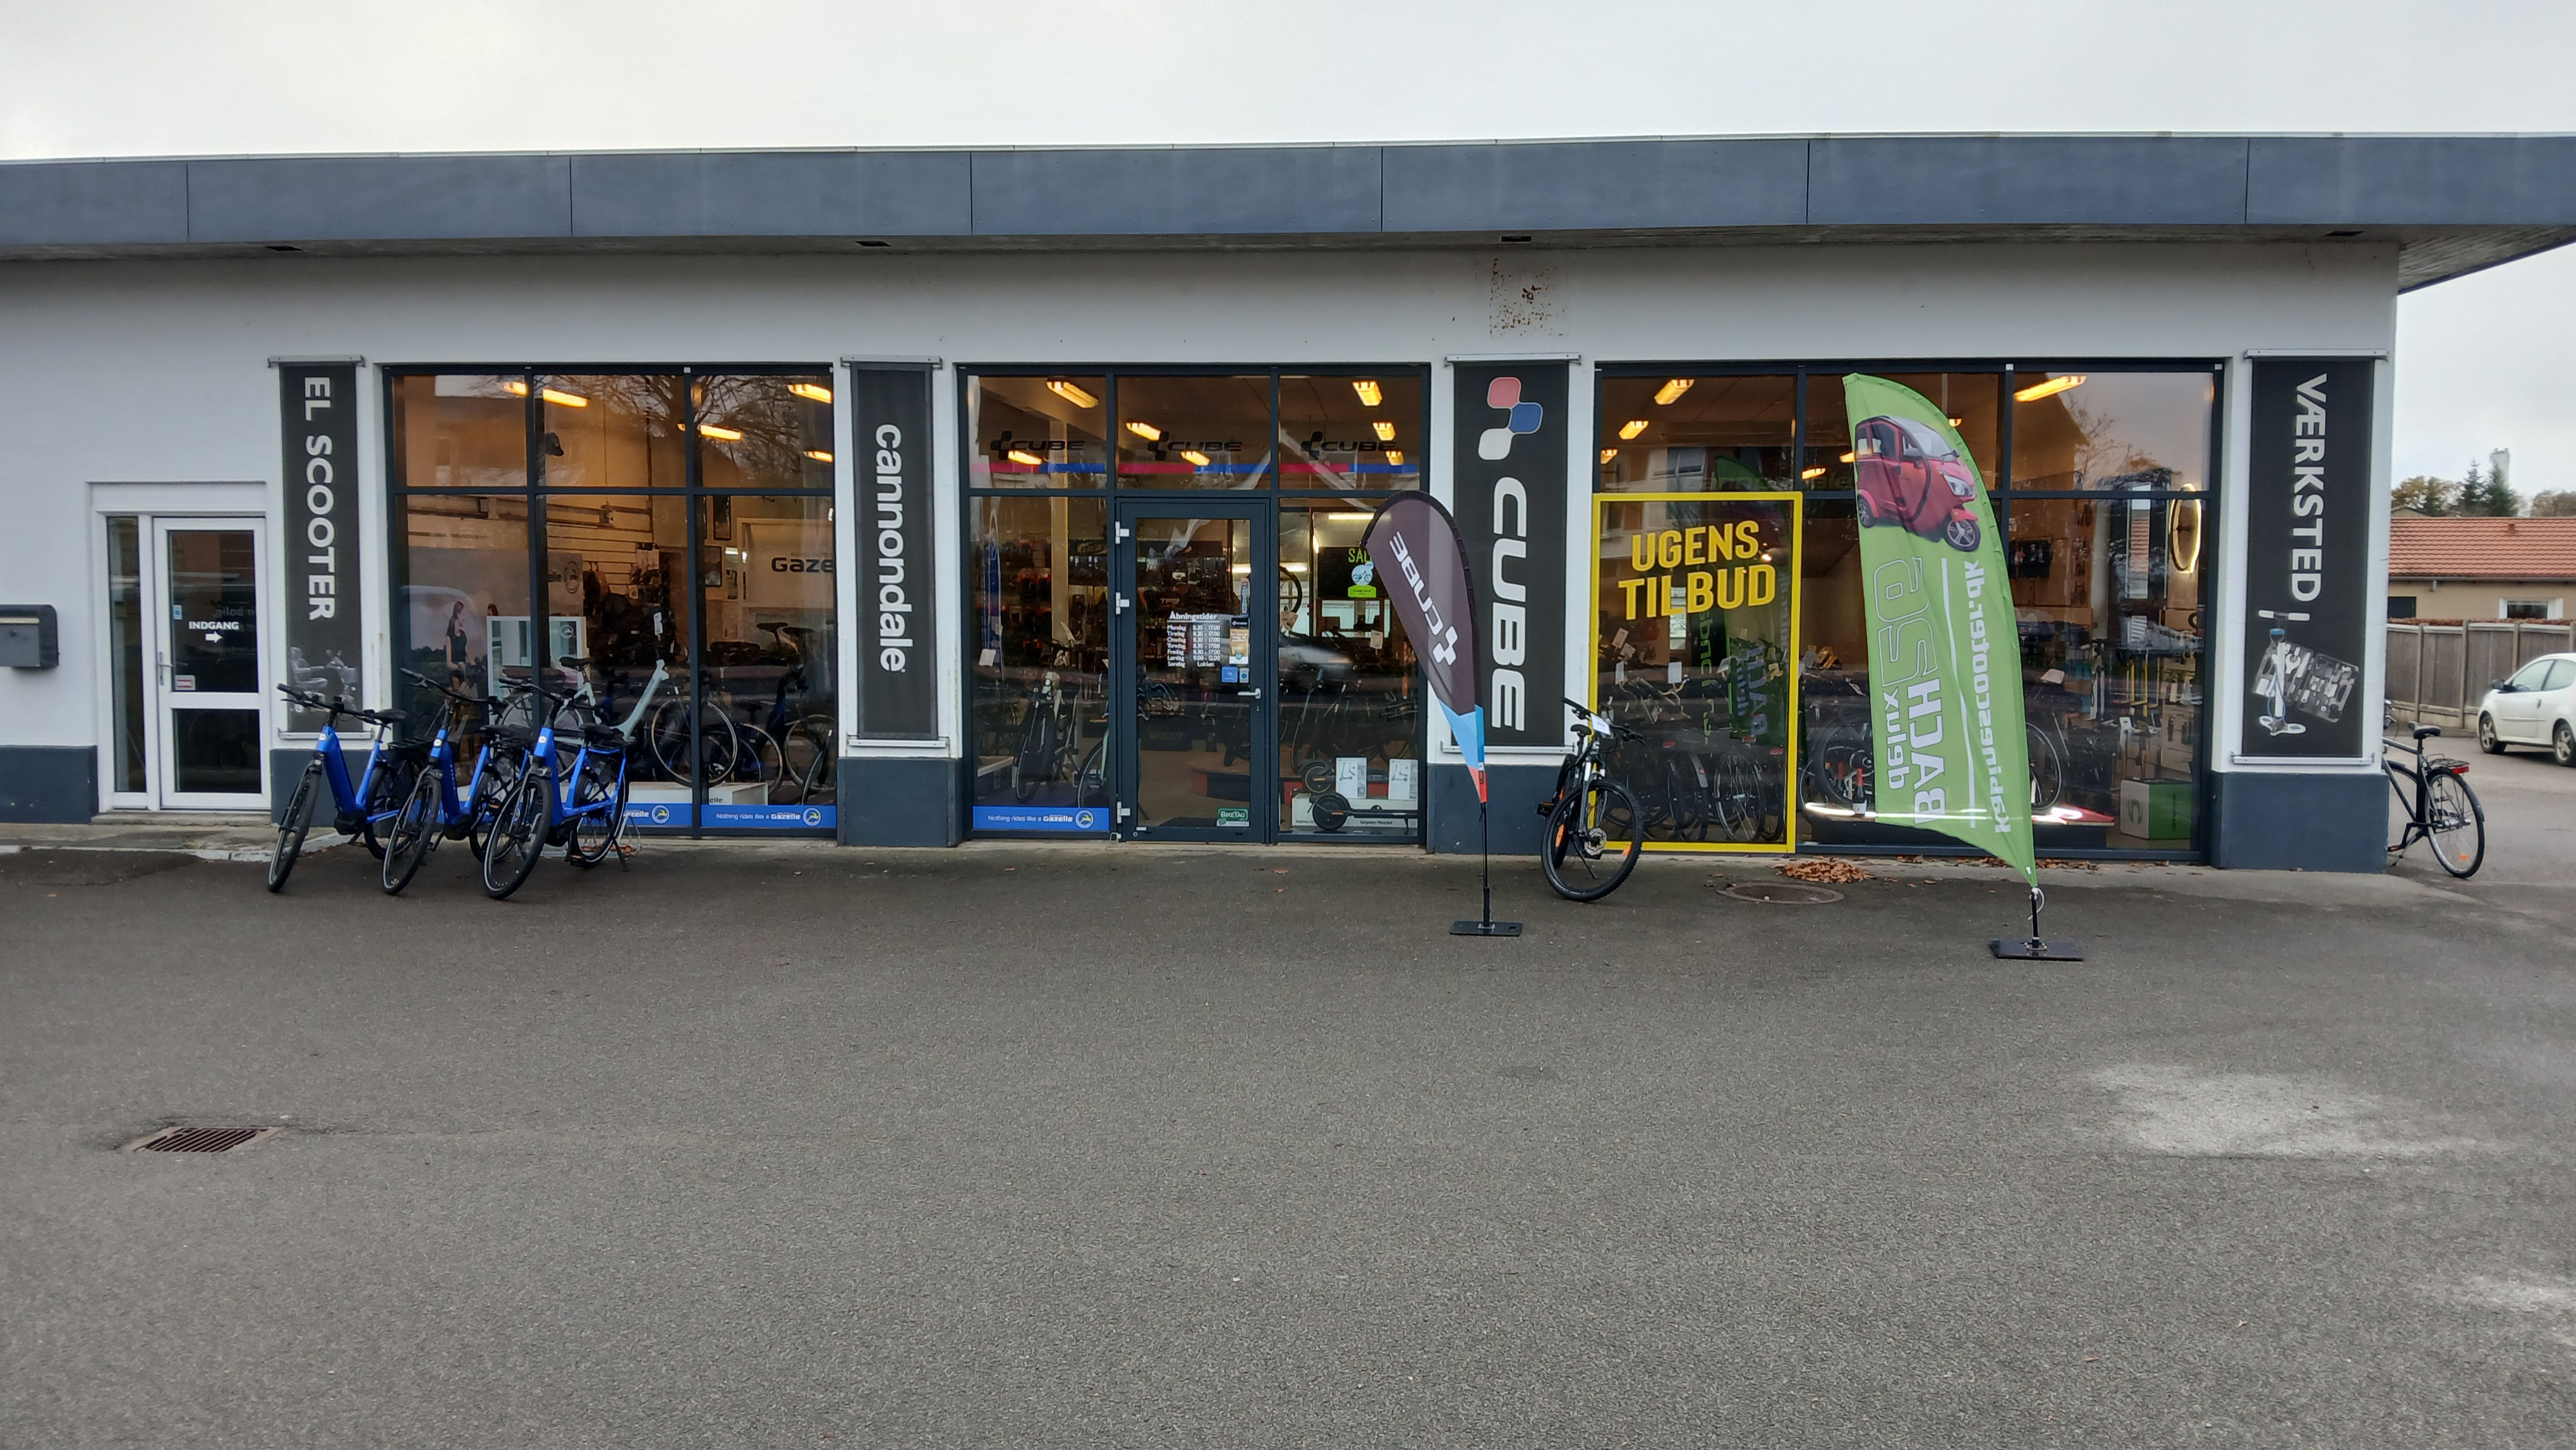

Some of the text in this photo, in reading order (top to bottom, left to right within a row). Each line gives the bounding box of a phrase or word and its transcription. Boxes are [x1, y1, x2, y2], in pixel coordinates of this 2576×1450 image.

[1011, 440, 1085, 450] CUBE
[1168, 441, 1243, 452] CUBE
[1321, 441, 1397, 452] CUBE
[305, 377, 336, 620] EL SCOOTER
[2292, 373, 2328, 602] VÆRKSTED
[875, 424, 914, 673] cannondale
[1348, 548, 1372, 563] SAL
[1631, 520, 1760, 572] UGENS
[1492, 476, 1527, 732] CUBE
[1618, 564, 1776, 620] TILBUD
[189, 621, 239, 630] INDGANG
[1169, 610, 1218, 622] Åbningstider
